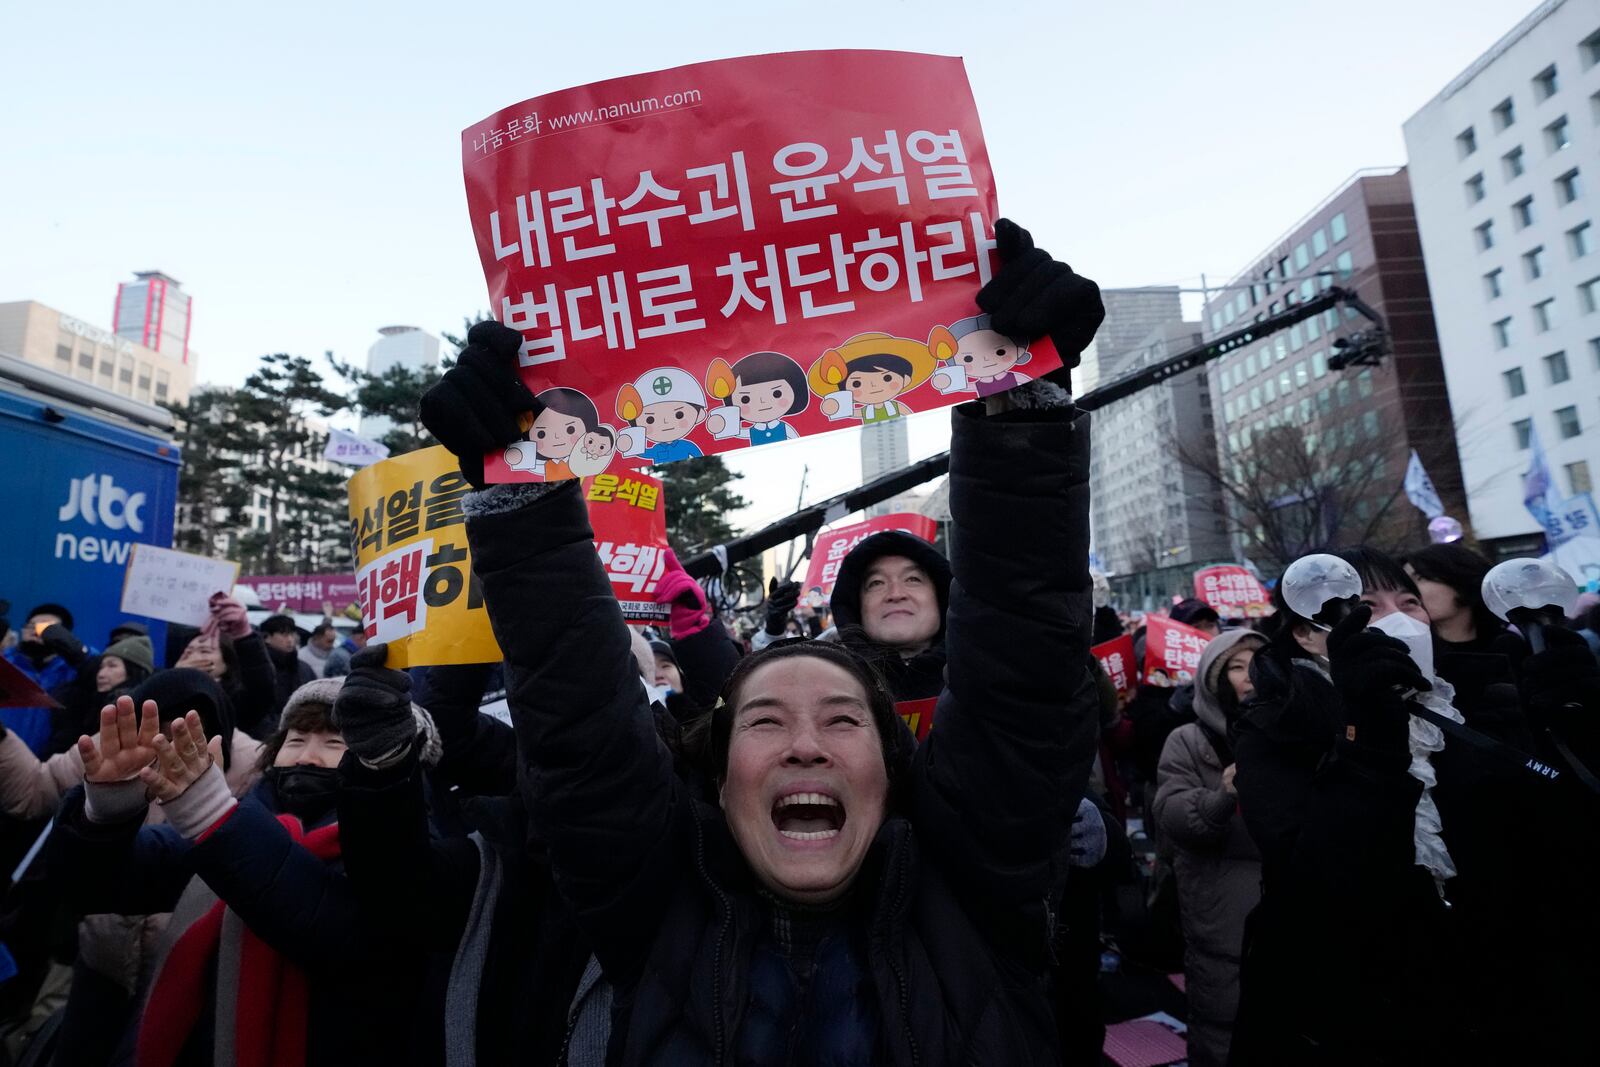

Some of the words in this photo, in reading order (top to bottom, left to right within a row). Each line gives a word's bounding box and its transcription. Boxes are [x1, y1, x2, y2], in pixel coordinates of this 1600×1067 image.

[473, 112, 543, 154] 나눔문화
[549, 89, 702, 130] www.nanum.com
[489, 151, 757, 268] 내란수괴
[770, 129, 979, 223] 윤석열
[500, 264, 706, 367] 법대로
[716, 211, 998, 326] 처단하라
[587, 474, 658, 511] 윤석열
[55, 533, 131, 565] new
[1525, 759, 1560, 779] ARMY
